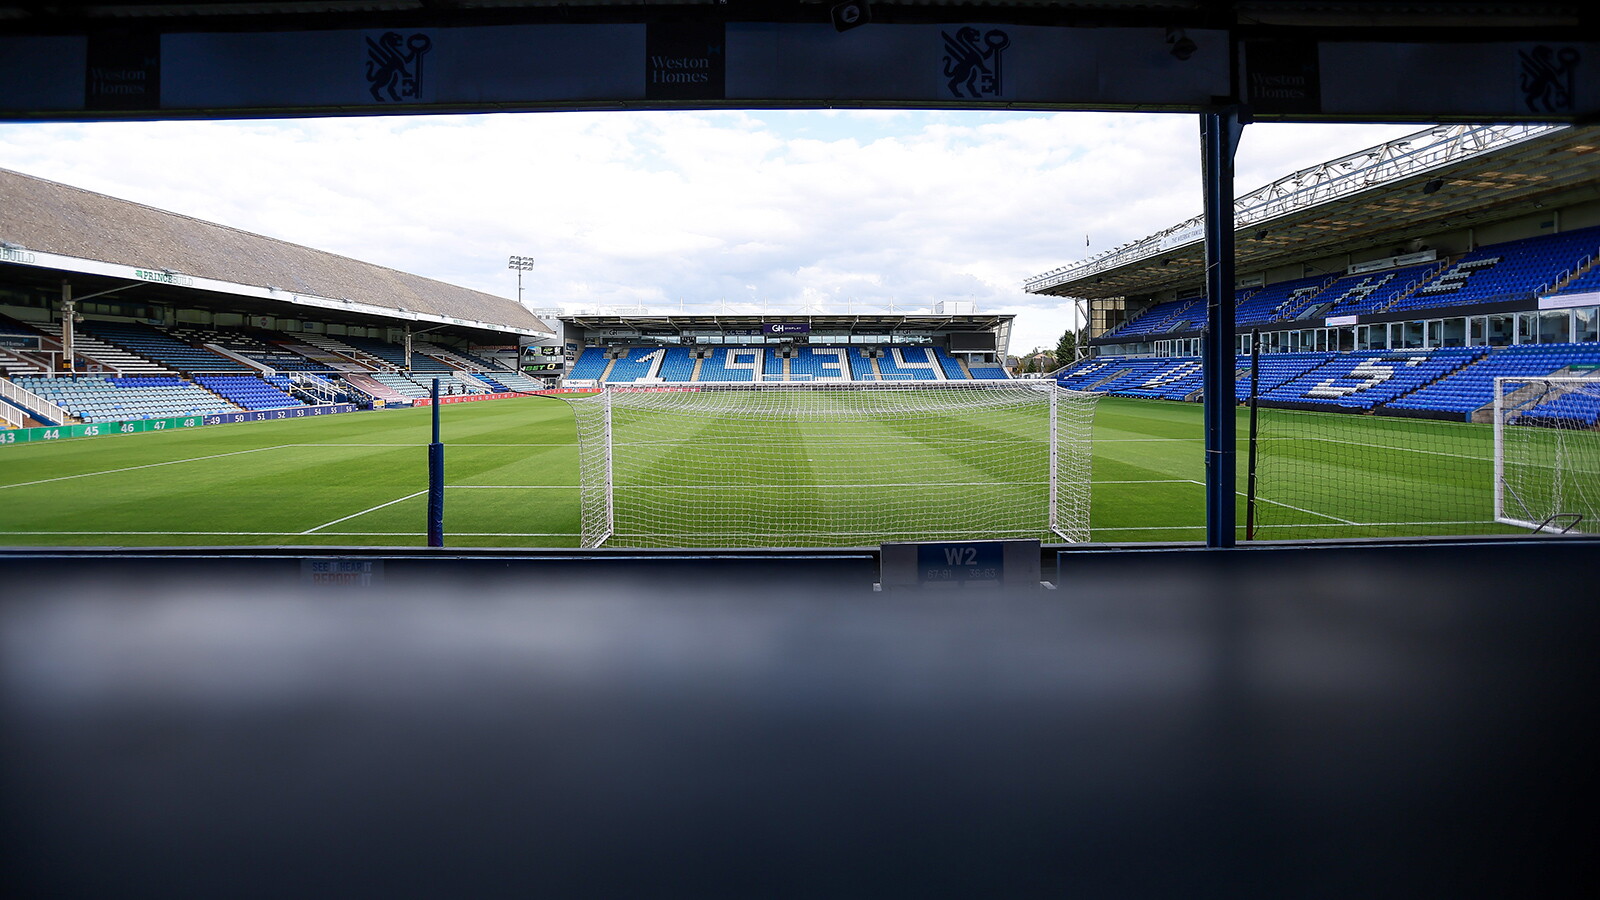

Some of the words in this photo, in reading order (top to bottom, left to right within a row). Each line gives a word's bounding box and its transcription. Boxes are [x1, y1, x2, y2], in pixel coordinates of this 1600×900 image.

[651, 56, 710, 69] Weston
[92, 67, 147, 81] Weston
[653, 70, 709, 83] Homes
[1251, 73, 1305, 86] Weston
[92, 81, 146, 95] Homes
[1253, 87, 1305, 99] Homes
[143, 270, 194, 287] PRINCEBUILD
[772, 324, 785, 332] GH
[211, 416, 221, 425] 49
[235, 414, 245, 423] 50
[257, 412, 266, 421] 51
[278, 411, 287, 419] 52
[297, 409, 305, 418] 53
[314, 408, 322, 416] 54
[331, 407, 338, 415] 55
[346, 405, 353, 413] 56
[0, 432, 15, 444] 43
[43, 429, 60, 440] 44
[84, 425, 99, 436] 45
[120, 422, 134, 433] 46
[153, 421, 166, 431] 47
[183, 418, 195, 428] 48
[944, 547, 978, 566] W2
[312, 561, 328, 572] SEE
[330, 561, 338, 572] IT
[340, 561, 362, 572] HEAR
[363, 561, 373, 572] IT
[313, 573, 359, 586] REPORT
[361, 573, 373, 587] IT
